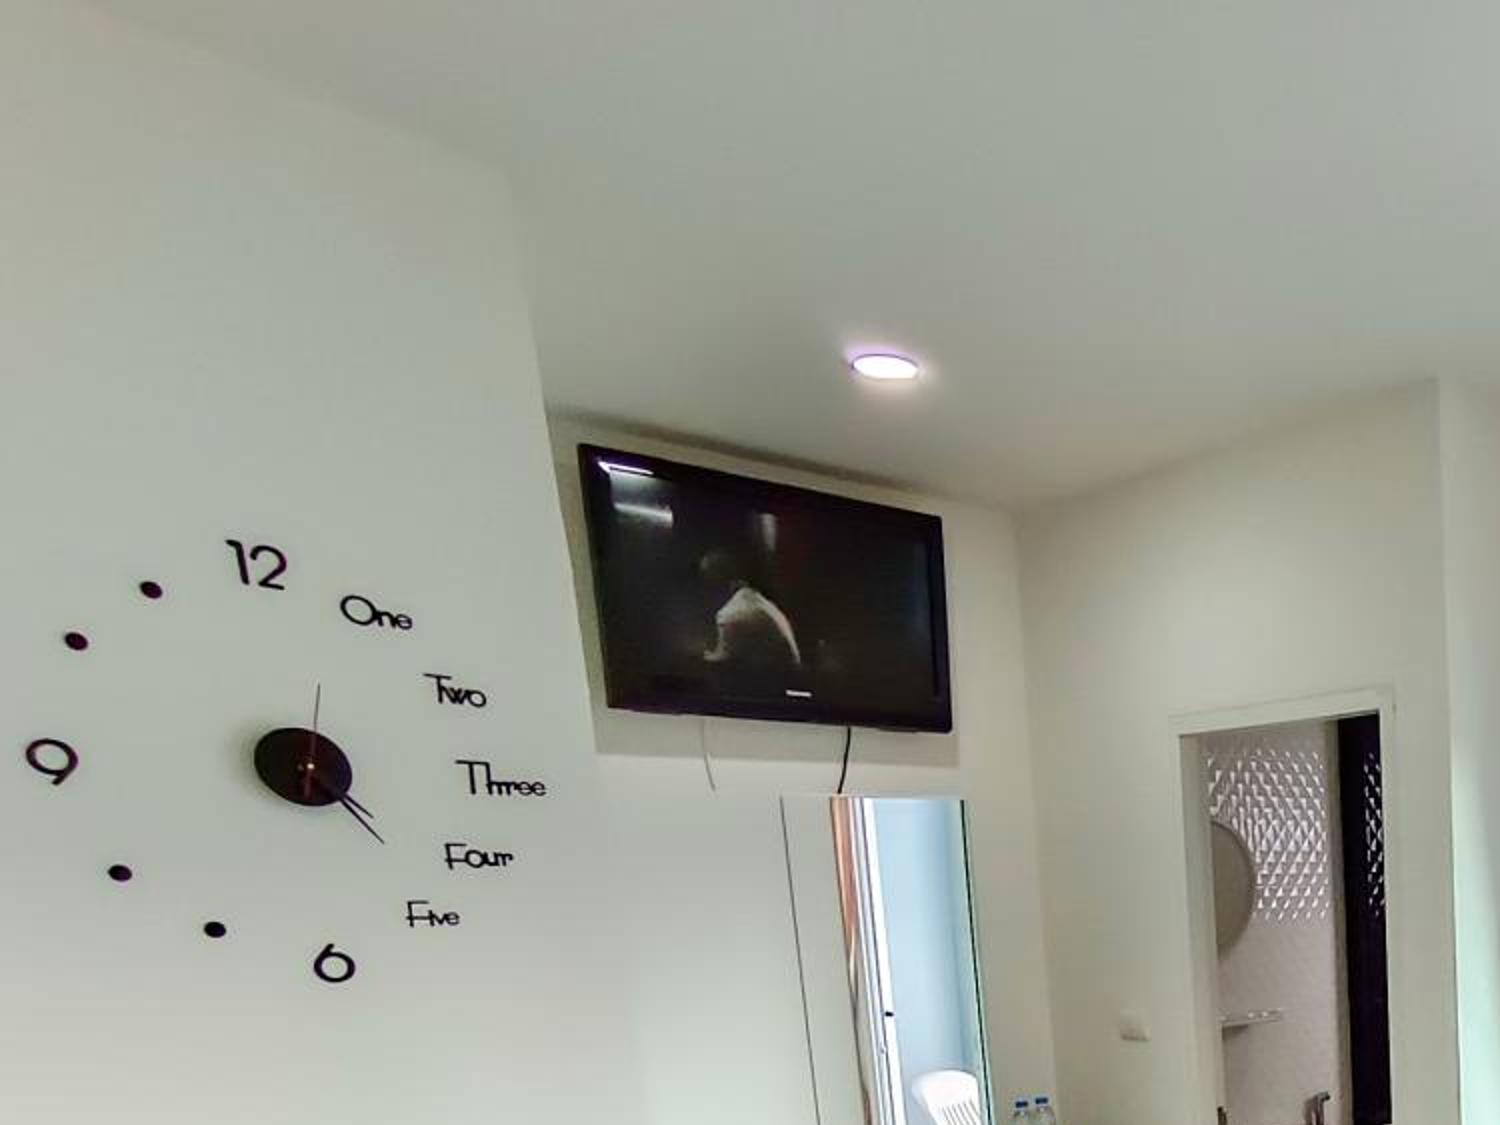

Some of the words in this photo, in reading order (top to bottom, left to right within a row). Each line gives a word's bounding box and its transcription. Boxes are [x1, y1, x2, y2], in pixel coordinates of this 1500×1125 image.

[225, 539, 287, 590] 12
[340, 595, 413, 630] One
[423, 673, 487, 708] Two
[25, 738, 78, 786] 9
[455, 760, 546, 796] Three
[444, 843, 514, 870] Four
[406, 900, 460, 928] Five
[313, 943, 356, 983] 6
